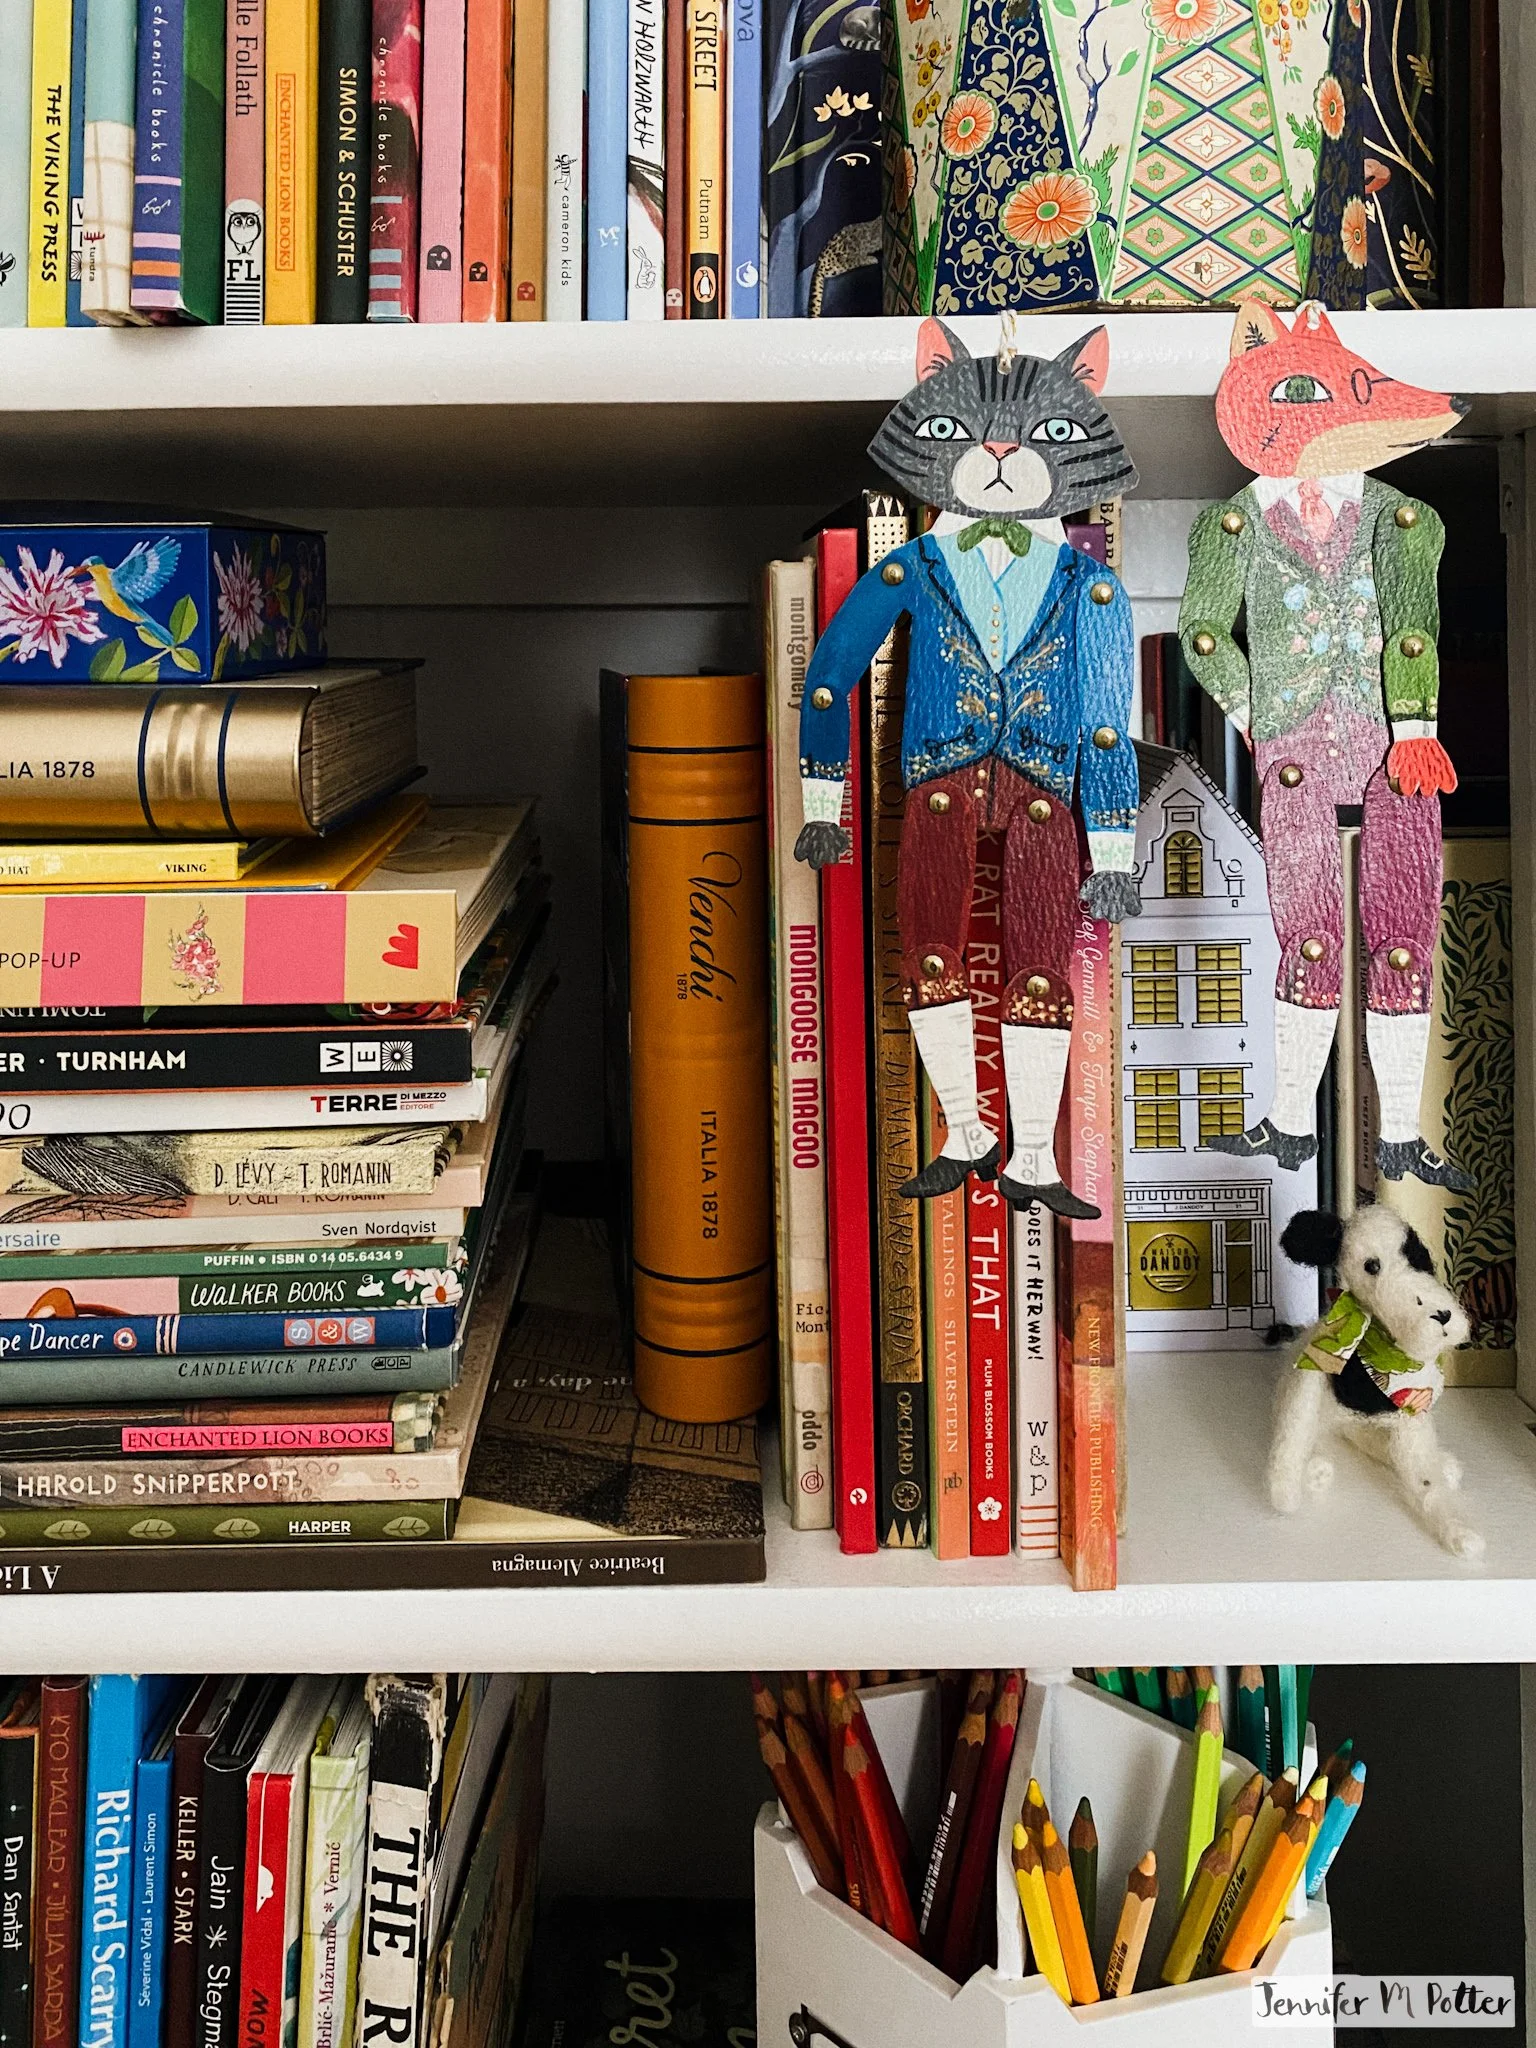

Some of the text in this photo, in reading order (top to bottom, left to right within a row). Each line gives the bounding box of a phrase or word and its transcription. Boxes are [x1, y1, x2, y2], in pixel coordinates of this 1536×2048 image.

[236, 35, 258, 117] Follath
[694, 10, 717, 91] STREET
[151, 5, 168, 163] chronicle books
[377, 37, 393, 184] chronicle books
[41, 85, 62, 282] THE VIKING PRESS
[275, 78, 292, 267] ENCHANTED LION BOOKS
[336, 67, 357, 277] SIMON & SCHUSTER
[700, 178, 712, 240] Putnam
[88, 246, 97, 281] tundra
[560, 195, 572, 286] cameron kids
[227, 259, 261, 282] FL
[788, 597, 805, 711] montgomery
[0, 760, 95, 778] IA 1878
[9, 865, 30, 875] HAT
[166, 863, 207, 873] VIKING
[971, 863, 1001, 925] RAT
[688, 851, 742, 1003] Venchi
[0, 952, 81, 968] POP-UP
[677, 972, 687, 1000] 1878
[1076, 950, 1103, 1020] Gemmill
[968, 942, 1001, 1070] REALLY
[57, 1050, 186, 1071] TURNHAM
[1083, 1031, 1104, 1053] &
[310, 1094, 397, 1112] TERRE
[413, 1092, 447, 1100] MEZZO
[214, 1158, 392, 1189] D. LÉVY T. ROMANIN
[701, 1110, 719, 1240] ITALIA 1878
[322, 1220, 437, 1238] Sven Nordqvist
[204, 1254, 254, 1267] PUFFIN
[272, 1252, 304, 1265] ISBN
[309, 1253, 316, 1264] 0
[395, 1250, 403, 1261] 9
[971, 1228, 1002, 1330] THAT
[1027, 1206, 1044, 1360] DOES IT HER WAY!
[1140, 1255, 1199, 1271] DANDOY
[288, 1279, 347, 1304] BOOKS
[29, 1323, 104, 1350] Dancer
[179, 1359, 297, 1377] CANDLEWICK
[308, 1357, 357, 1374] PRESS
[944, 1320, 958, 1453] SILVERSTEIN
[126, 1428, 388, 1447] ENCHANTED LION BOOKS
[801, 1410, 822, 1450] oddo
[897, 1391, 914, 1475] ORCHARD
[984, 1358, 994, 1480] PLUM BLOSSOM BOOKS
[1088, 1317, 1104, 1528] NEW FRONTIER PUBLISHING
[1030, 1446, 1049, 1466] &
[18, 1474, 117, 1497] HAROLD
[289, 1521, 351, 1533] HARPER
[0, 1566, 61, 1589] A Li
[492, 1553, 666, 1576] Beatrice Alemagna
[48, 1714, 70, 1760] KYO
[47, 1767, 70, 1873] MACLEAR
[2, 1836, 23, 1950] Dan Santat
[174, 1796, 198, 1944] KELLER STARK
[210, 1856, 233, 1909] Jain
[324, 1842, 341, 1894] Vernić
[367, 1827, 421, 1959] THE
[82, 1789, 131, 2048] Richard Scarry
[138, 1812, 156, 2007] Séverine Vidal Laurent Simon
